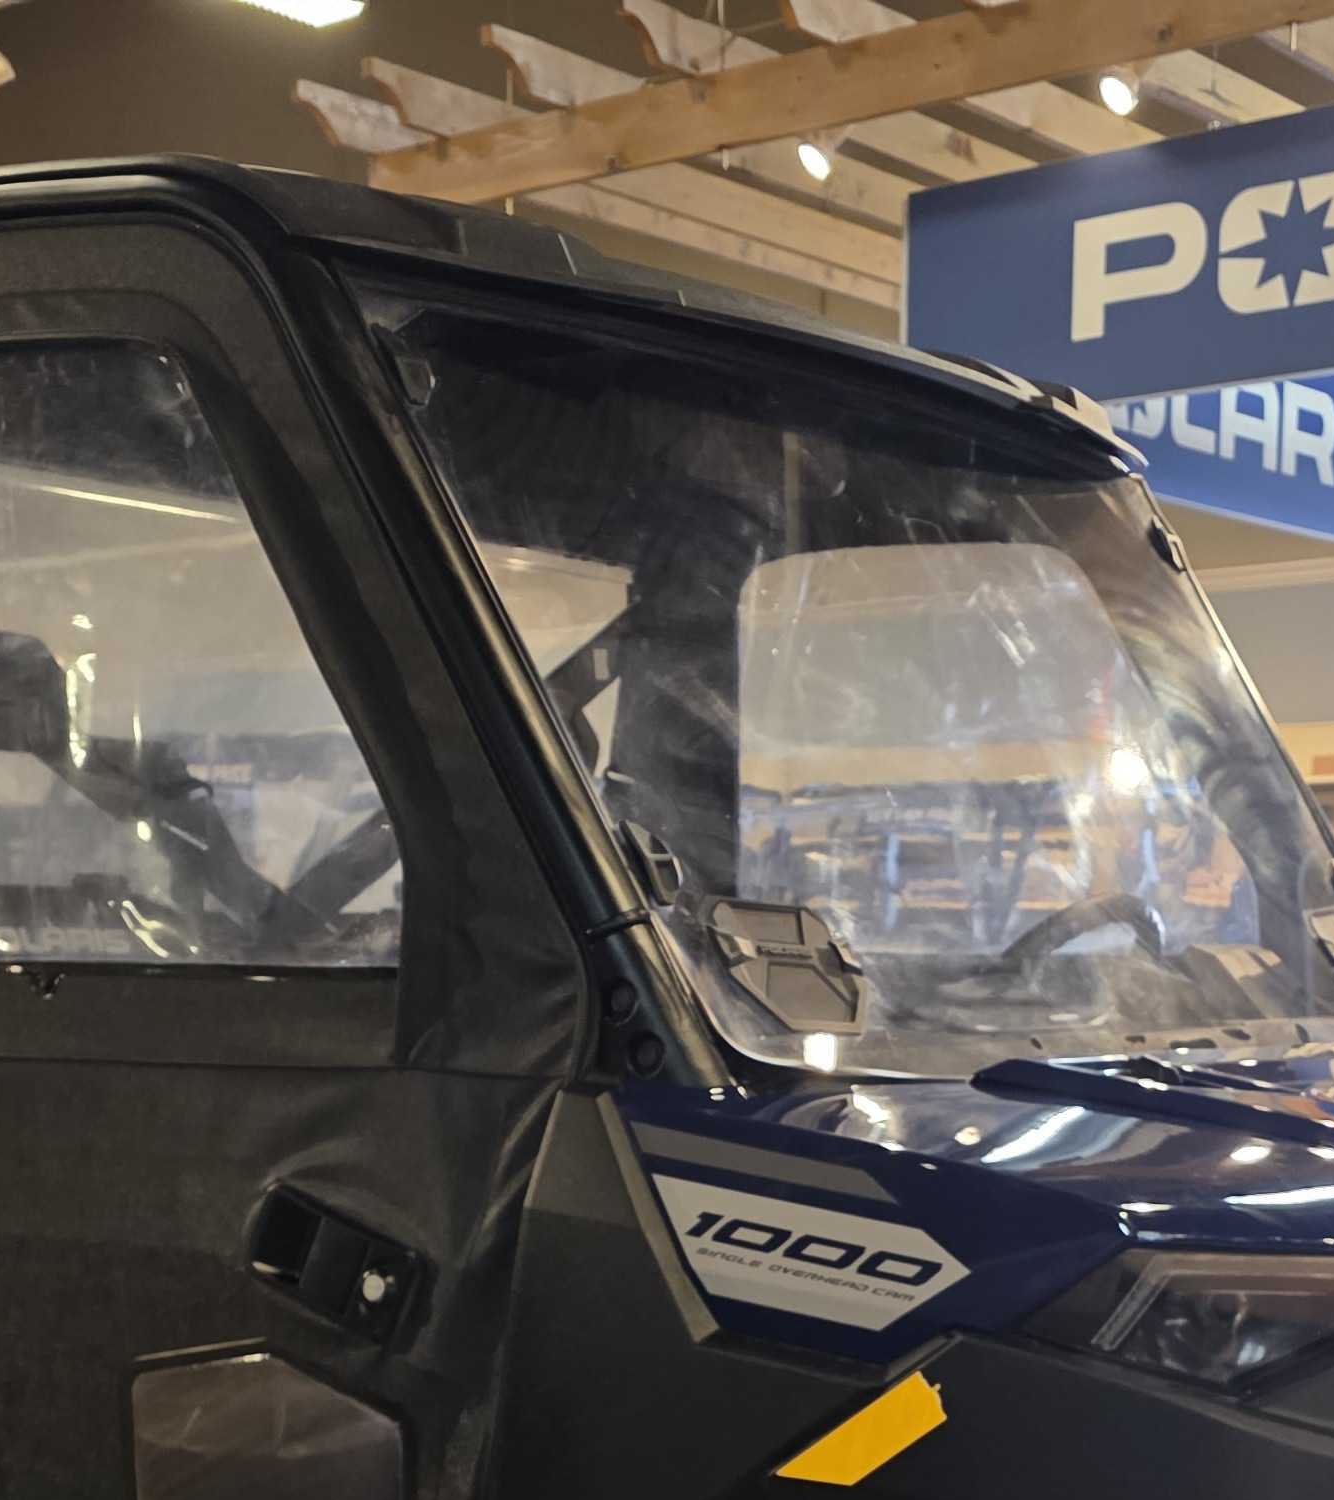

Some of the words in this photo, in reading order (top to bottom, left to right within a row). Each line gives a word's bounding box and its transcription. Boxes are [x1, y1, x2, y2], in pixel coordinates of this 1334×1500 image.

[684, 1210, 943, 1287] 1000
[695, 1246, 764, 1269] SINGLE
[767, 1263, 871, 1294] OVERHEAD
[870, 1286, 916, 1303] CAM
